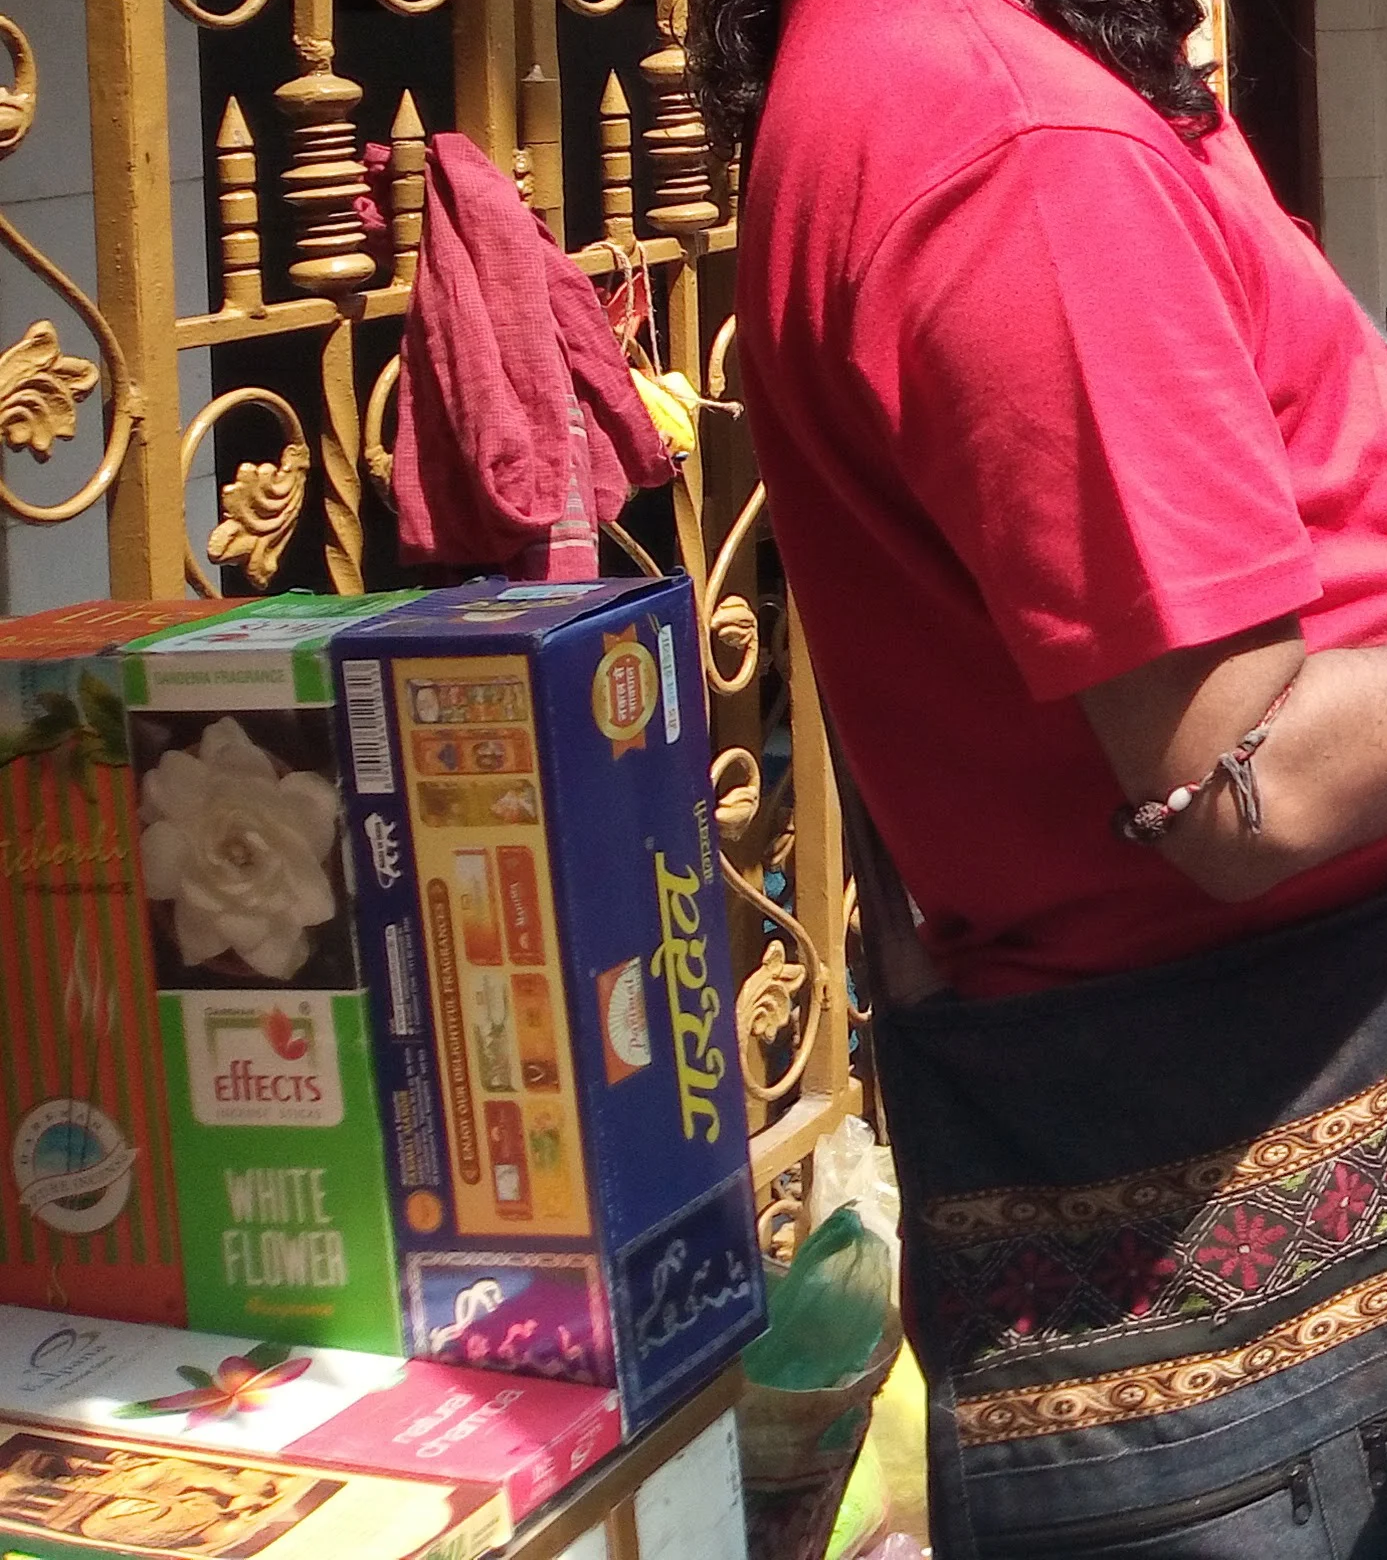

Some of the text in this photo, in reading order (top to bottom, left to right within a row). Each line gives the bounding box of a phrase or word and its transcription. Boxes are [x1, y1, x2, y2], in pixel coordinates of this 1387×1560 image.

[215, 668, 286, 684] FRAGRANCE
[649, 852, 723, 1144] गुरुदेव
[435, 902, 475, 1162] ENJOY OUR DELIGHTFUL FRAGRANCES
[223, 1167, 334, 1224] WHITE
[221, 1229, 348, 1288] FLOWER
